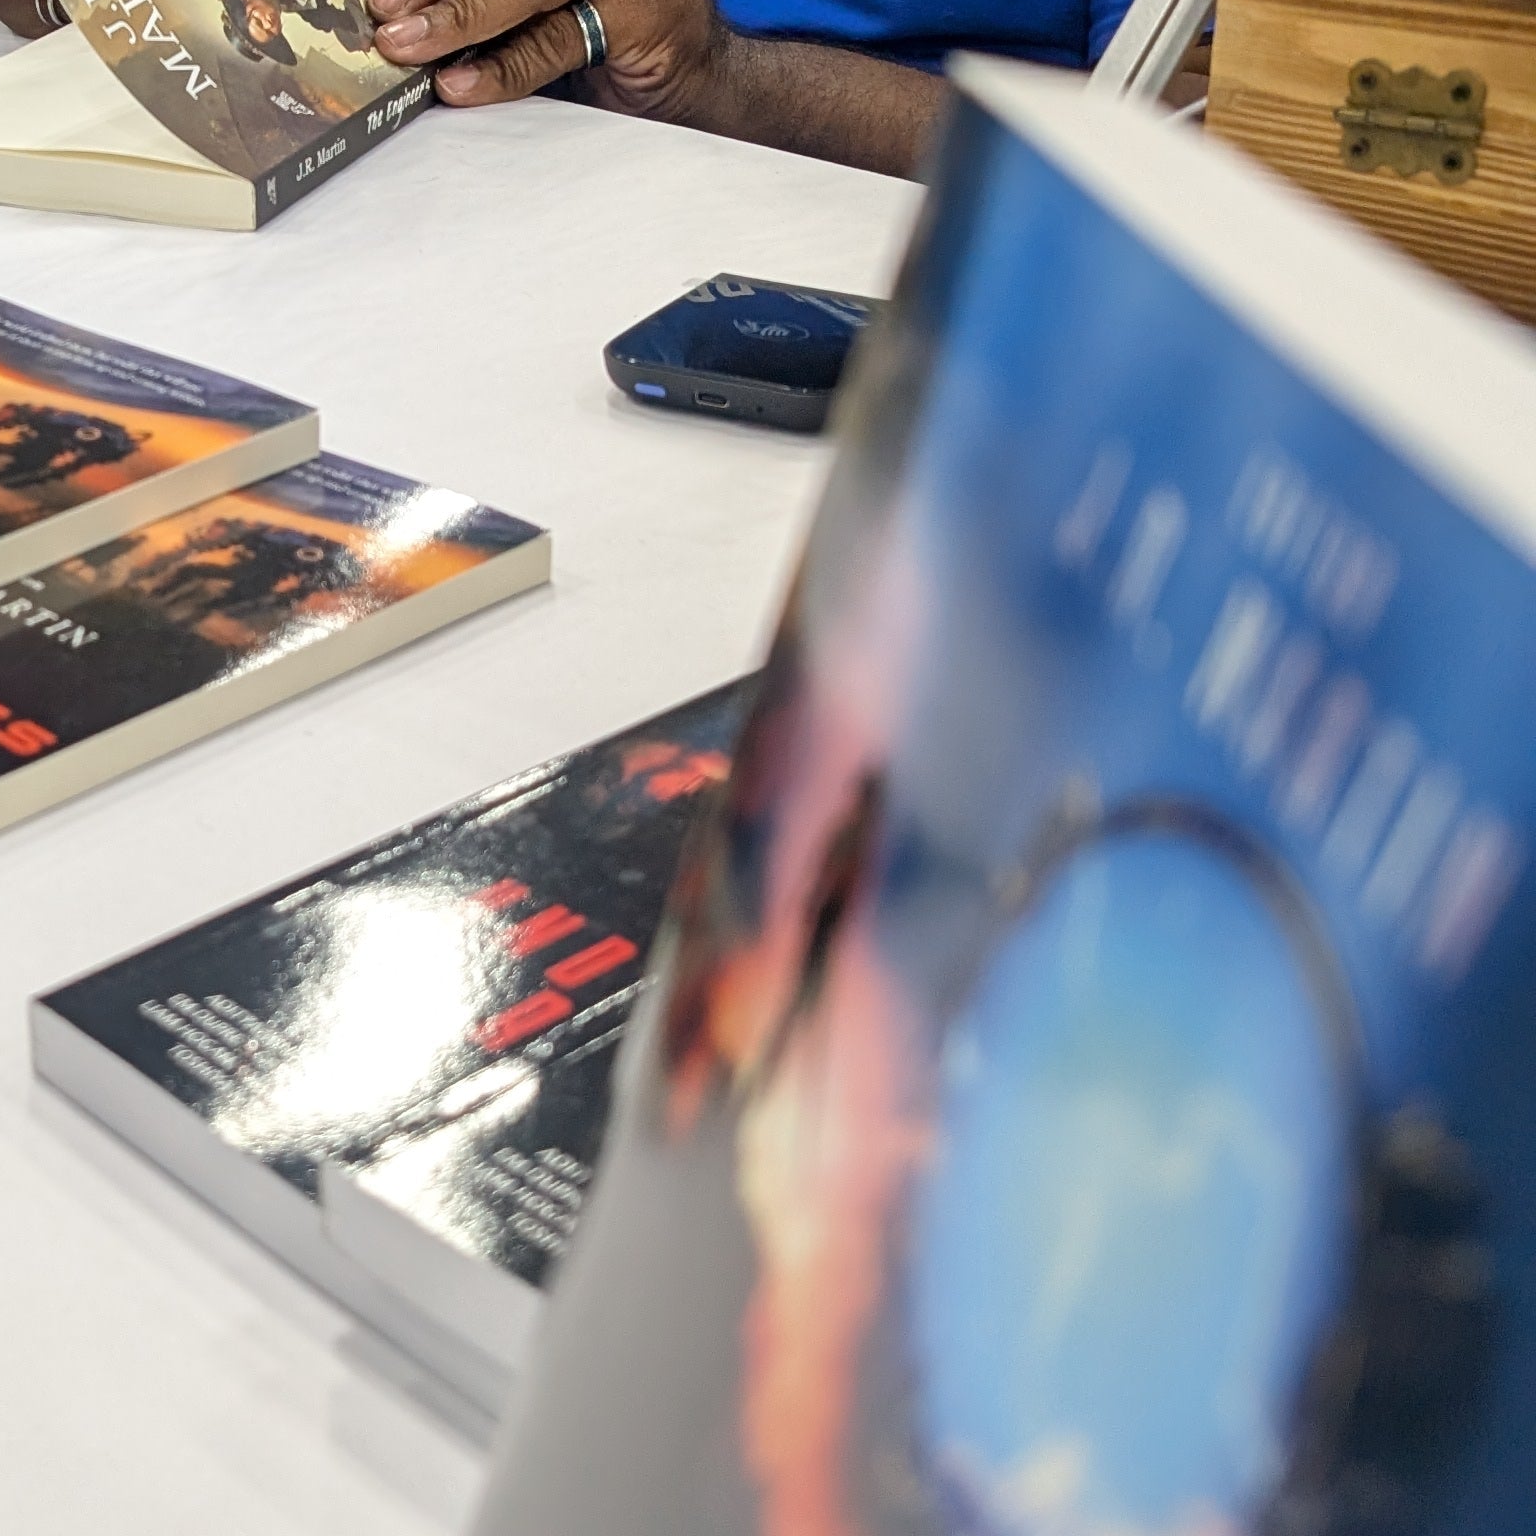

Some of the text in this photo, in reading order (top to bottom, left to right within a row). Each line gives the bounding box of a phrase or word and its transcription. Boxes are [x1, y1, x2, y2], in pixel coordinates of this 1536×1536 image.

[296, 157, 315, 182] J.R.
[317, 137, 346, 168] Martin
[367, 109, 384, 135] The
